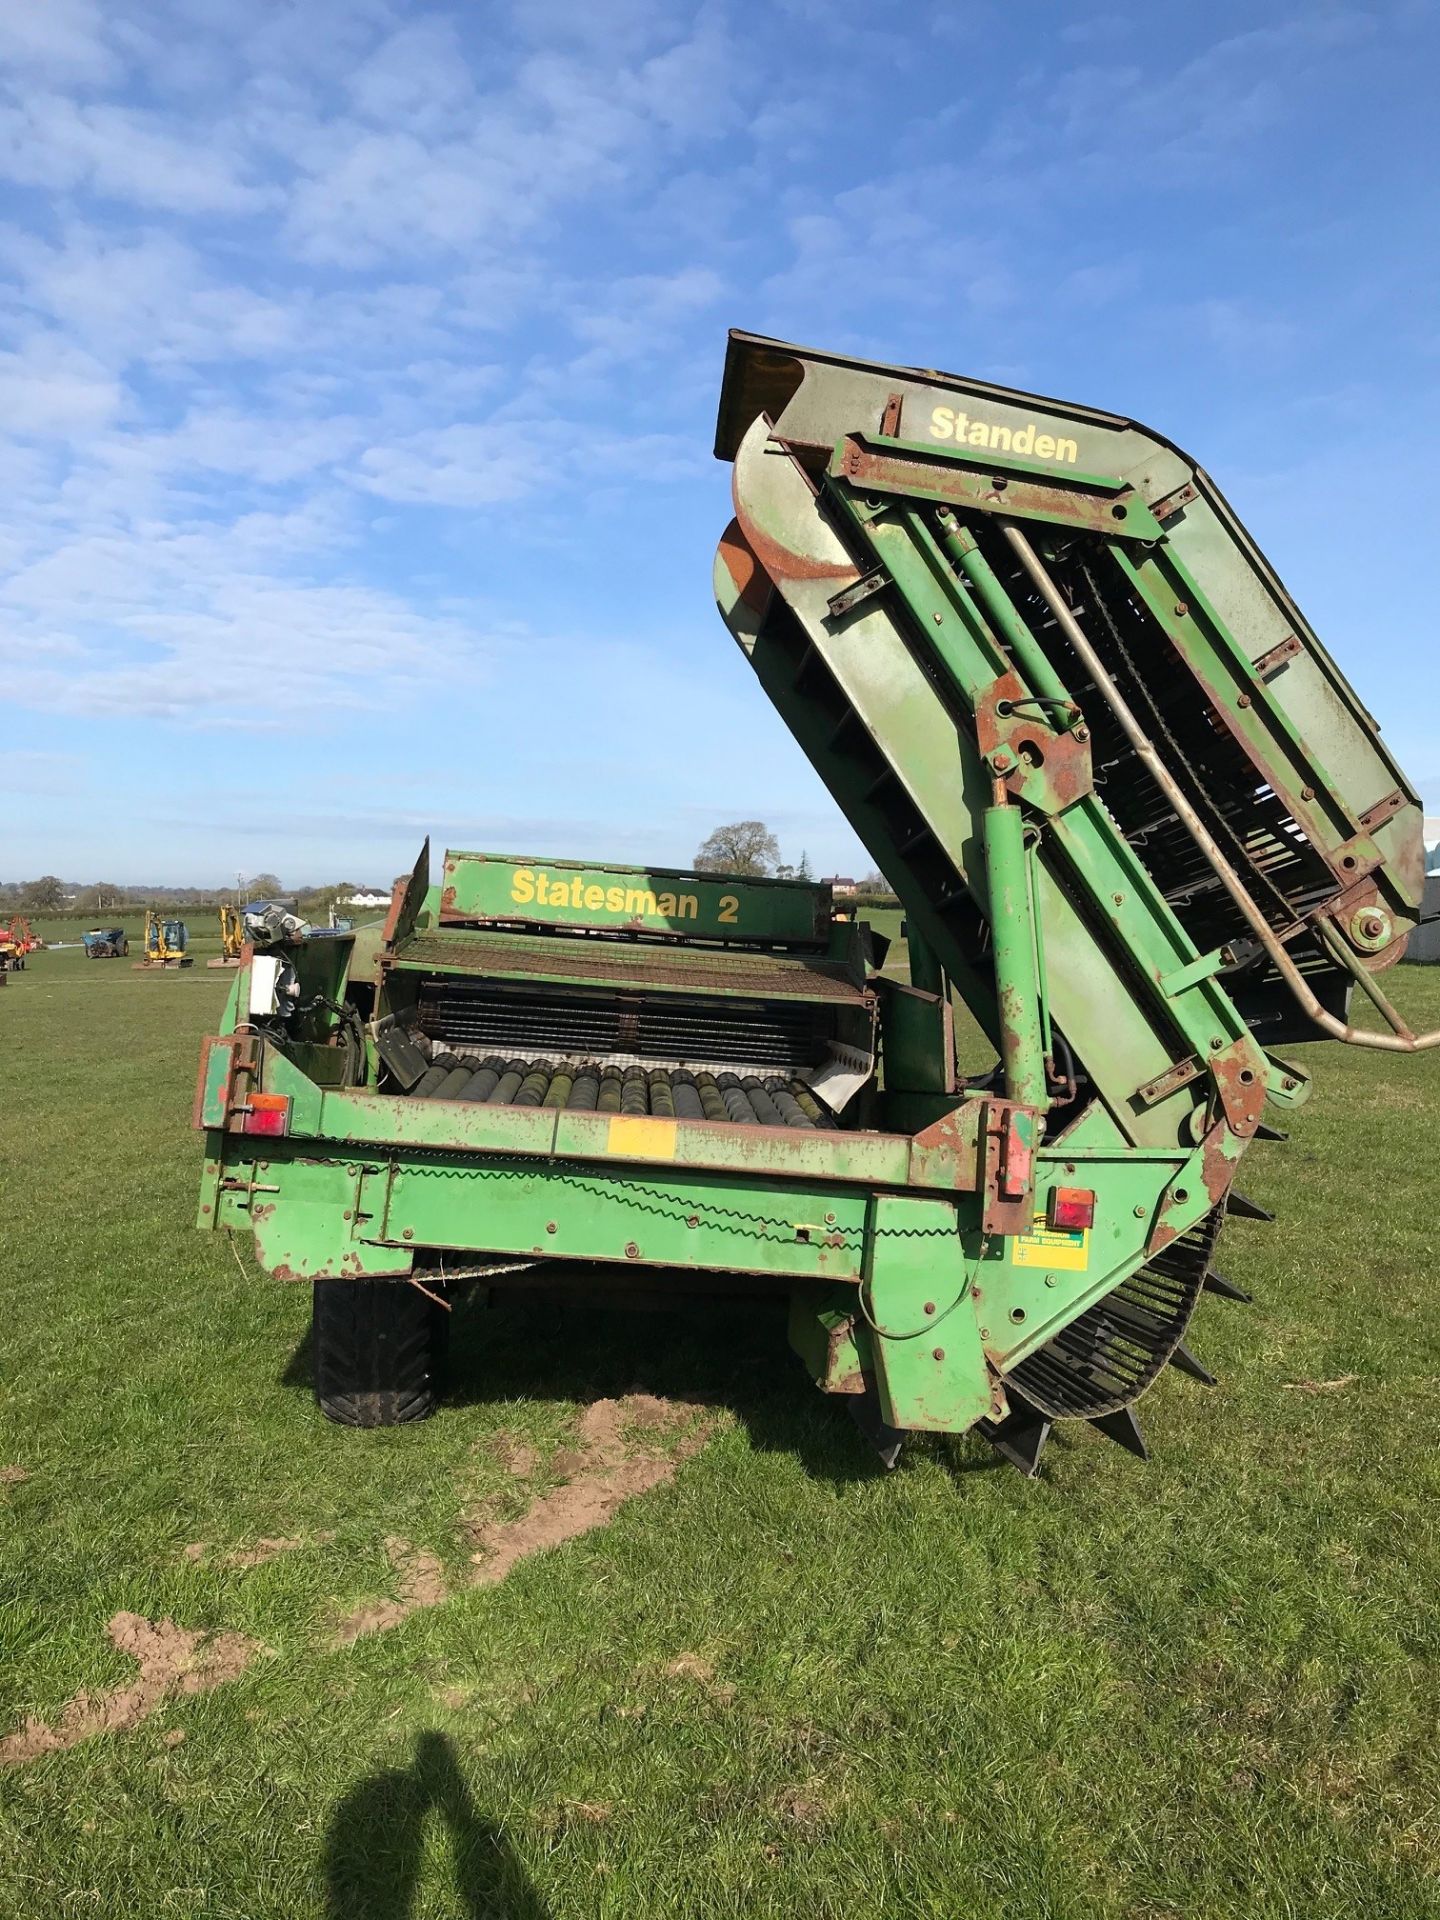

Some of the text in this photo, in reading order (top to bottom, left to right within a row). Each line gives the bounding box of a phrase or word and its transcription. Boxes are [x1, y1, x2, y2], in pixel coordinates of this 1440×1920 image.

[929, 406, 1078, 463] Standen
[511, 869, 739, 924] Statesman 2
[1041, 1237, 1082, 1247] EQUIPMENT
